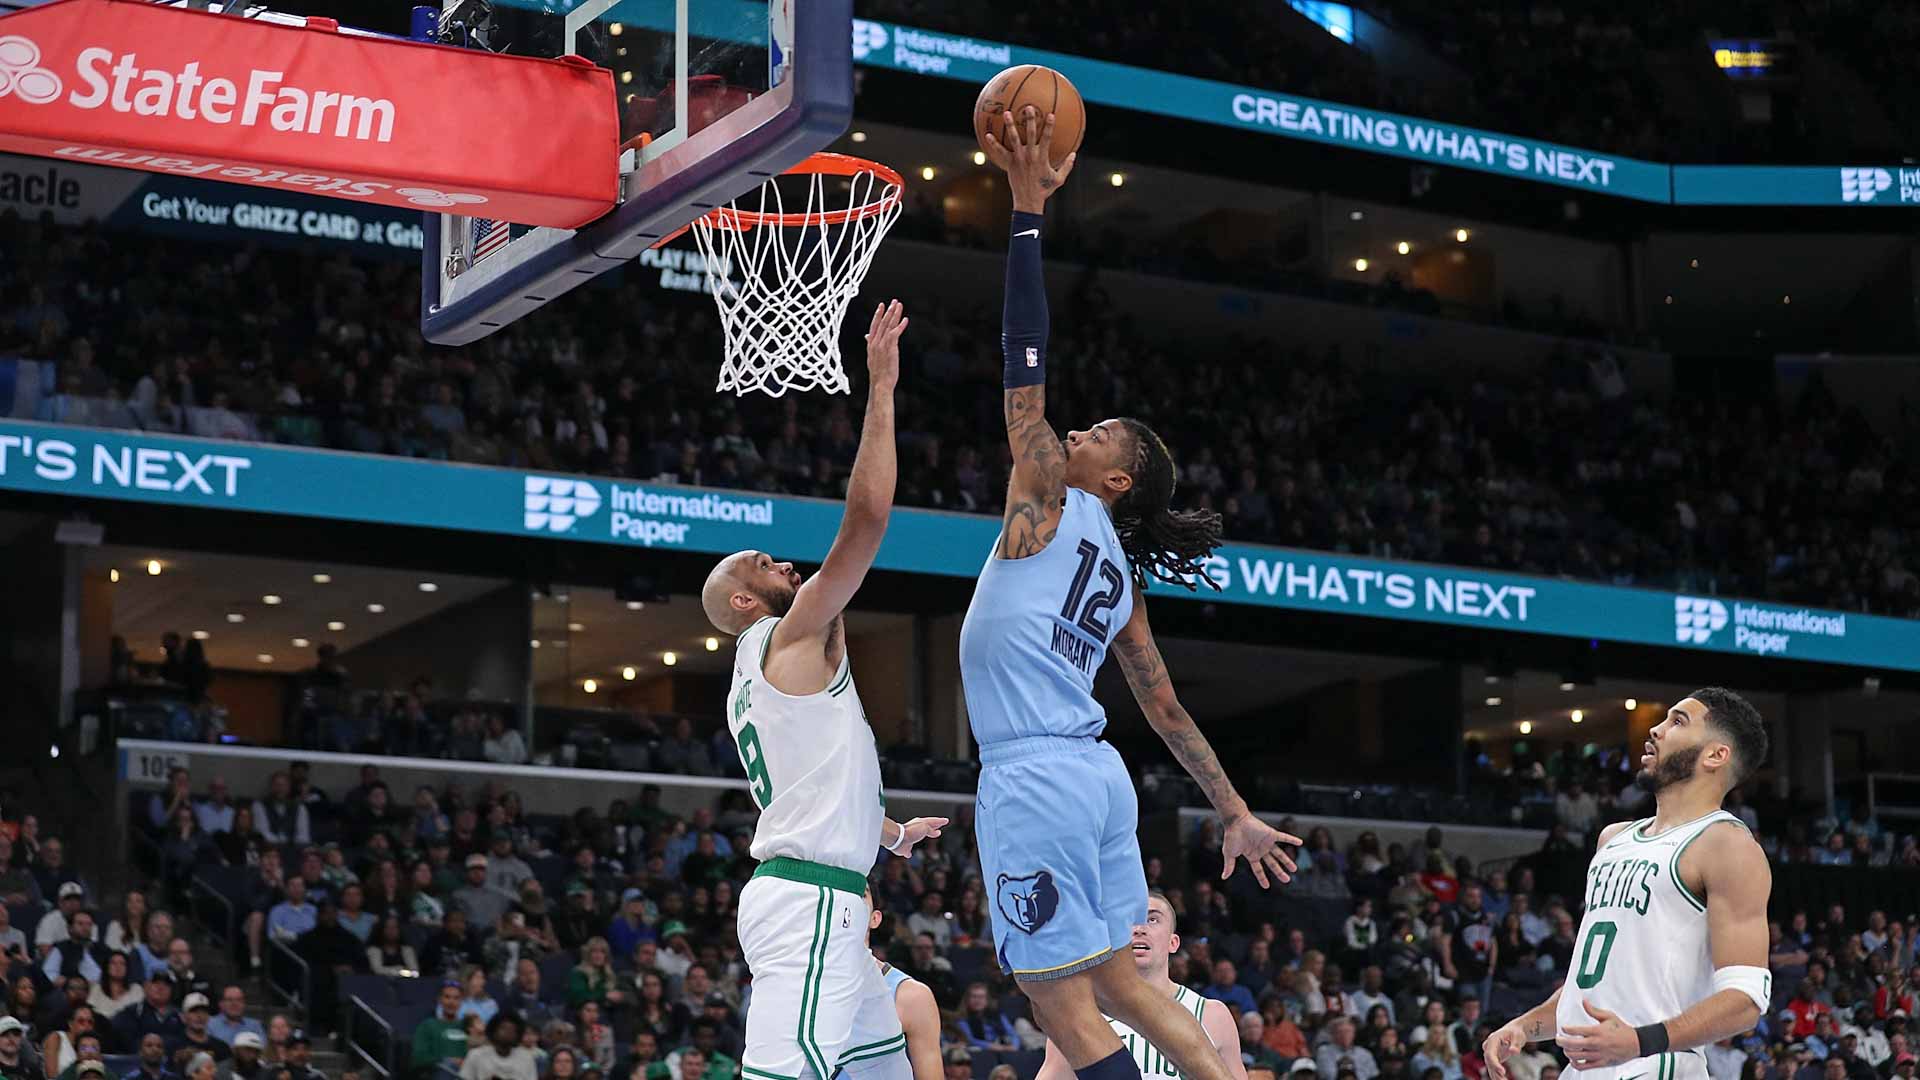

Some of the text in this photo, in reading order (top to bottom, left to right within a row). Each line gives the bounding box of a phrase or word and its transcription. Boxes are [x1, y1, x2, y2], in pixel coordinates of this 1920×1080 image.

[894, 25, 1011, 65] International
[894, 46, 951, 73] Paper
[1231, 93, 1614, 186] CREATING WHAT'S NEXT
[143, 192, 181, 219] Get
[183, 197, 231, 225] Your
[233, 203, 298, 233] GRIZZ
[301, 210, 360, 241] CARD
[362, 222, 384, 244] at
[92, 443, 251, 496] NEXT
[611, 484, 773, 526] International
[611, 511, 690, 547] Paper
[1060, 537, 1124, 644] 12
[1238, 557, 1416, 608] WHAT'S
[1424, 577, 1536, 621] NEXT
[1733, 602, 1845, 637] International
[1735, 626, 1789, 655] Paper
[1051, 622, 1097, 675] MORANT
[738, 721, 773, 810] 9
[1576, 921, 1617, 989] 0
